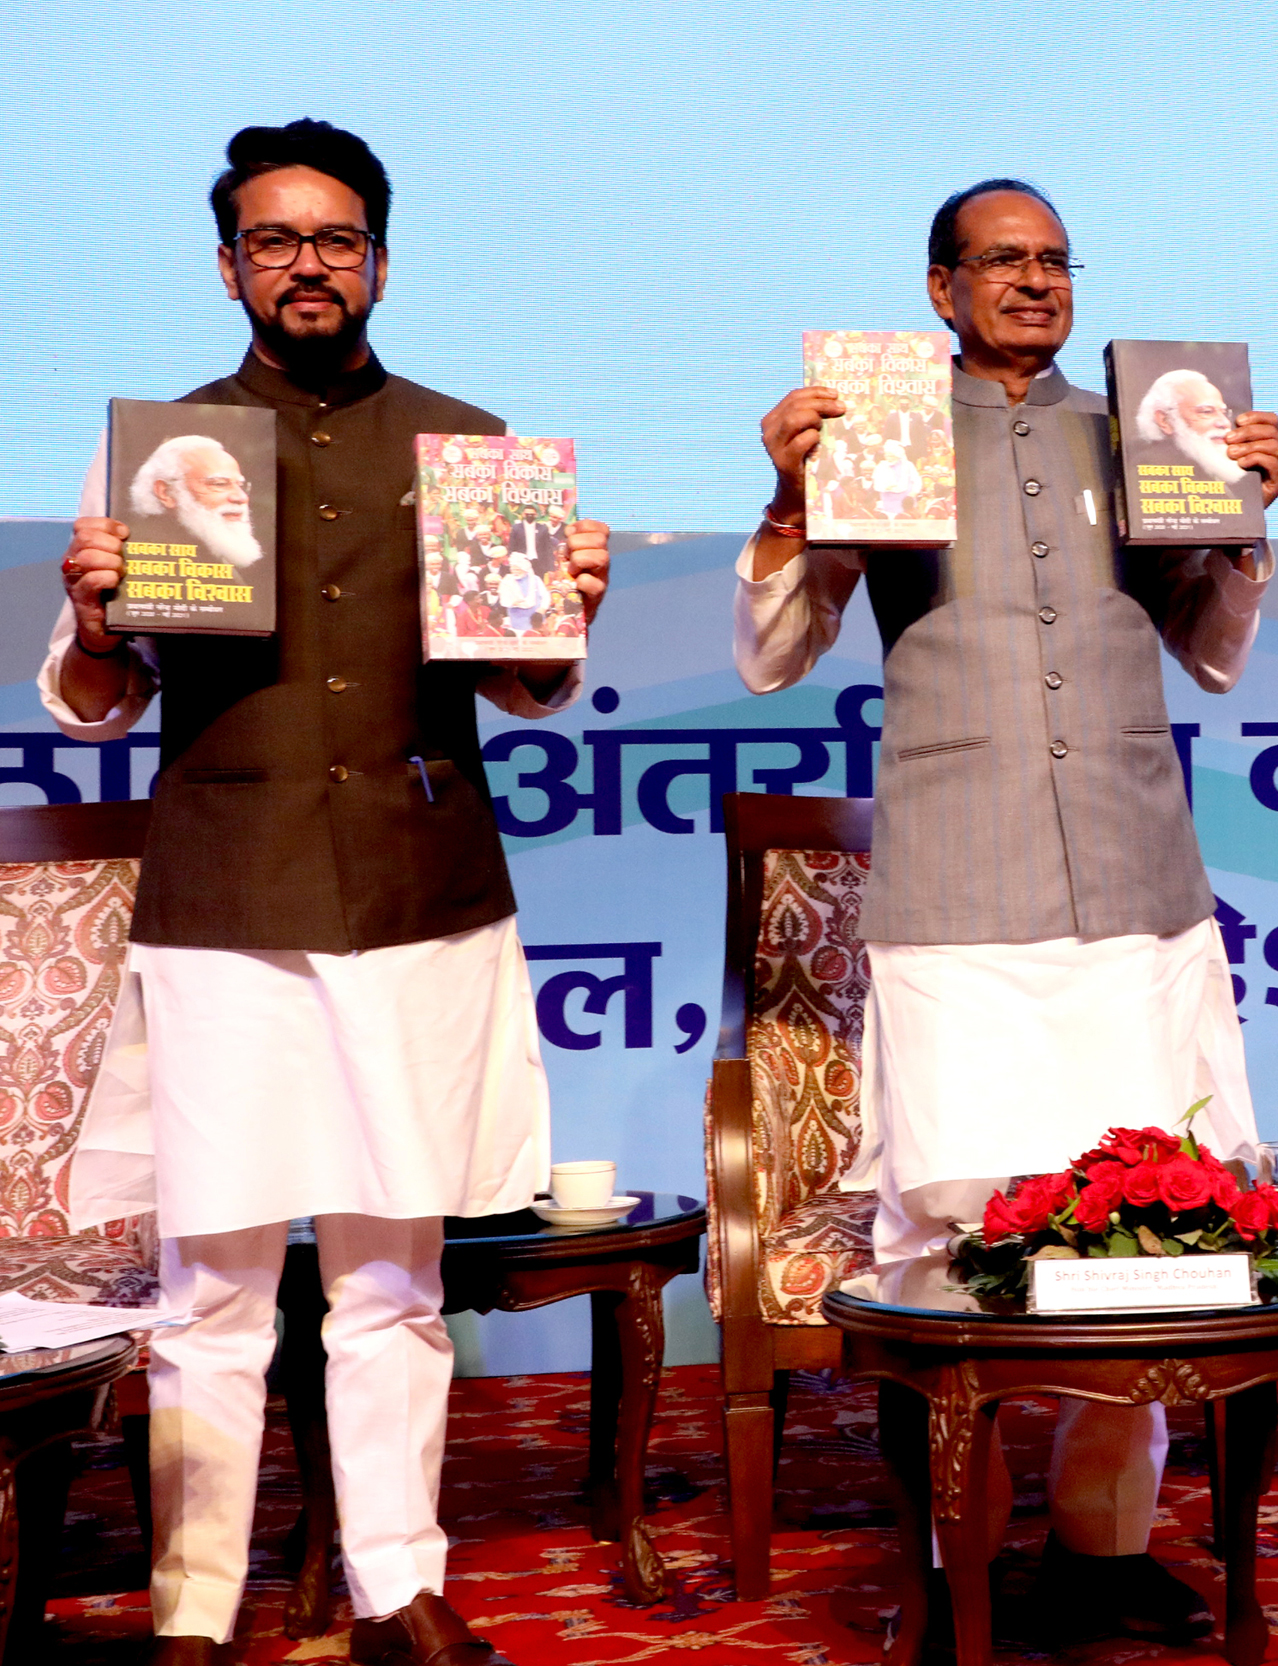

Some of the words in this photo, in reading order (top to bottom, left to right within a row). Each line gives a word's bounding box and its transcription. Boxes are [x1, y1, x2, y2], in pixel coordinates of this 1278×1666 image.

[831, 358, 875, 373] सबका
[881, 353, 928, 373] विकास
[878, 373, 937, 396] विश्वास
[450, 463, 498, 480] सबका
[503, 460, 555, 481] विकास
[1137, 464, 1171, 476] सबका
[1171, 465, 1195, 477] साथ
[443, 486, 494, 504] सबका
[501, 481, 564, 506] विश्वास
[1138, 480, 1180, 494] सबका
[1179, 477, 1226, 495] विकास
[1140, 498, 1187, 515] सबका
[1187, 495, 1244, 515] विश्वास
[126, 542, 168, 557] सबका
[169, 544, 198, 558] साथ
[126, 559, 178, 577] सबका
[178, 557, 235, 580] विकास
[126, 580, 184, 600] सबका
[185, 578, 254, 603] विश्वास
[1055, 1269, 1080, 1282] Shri
[1084, 1269, 1130, 1283] Shivraj
[1133, 1268, 1168, 1283] Singh
[1173, 1267, 1232, 1280] Chouhan
